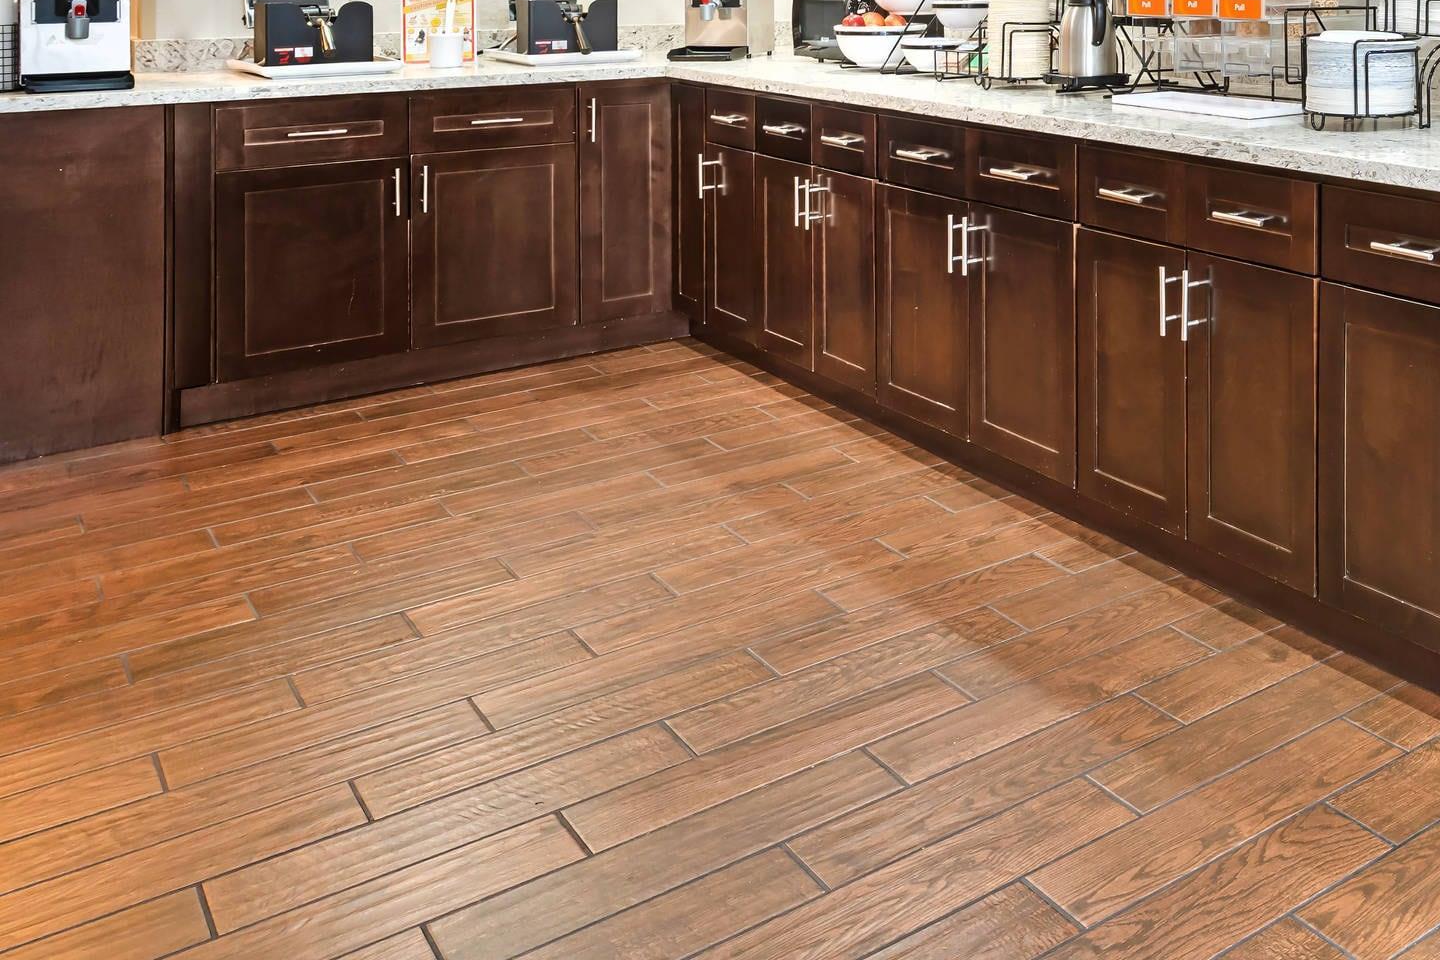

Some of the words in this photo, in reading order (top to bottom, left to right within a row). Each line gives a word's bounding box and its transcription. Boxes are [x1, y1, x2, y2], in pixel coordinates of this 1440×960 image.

[1141, 0, 1152, 8] Pull
[1187, 0, 1198, 8] Pull
[1234, 3, 1245, 11] Pull
